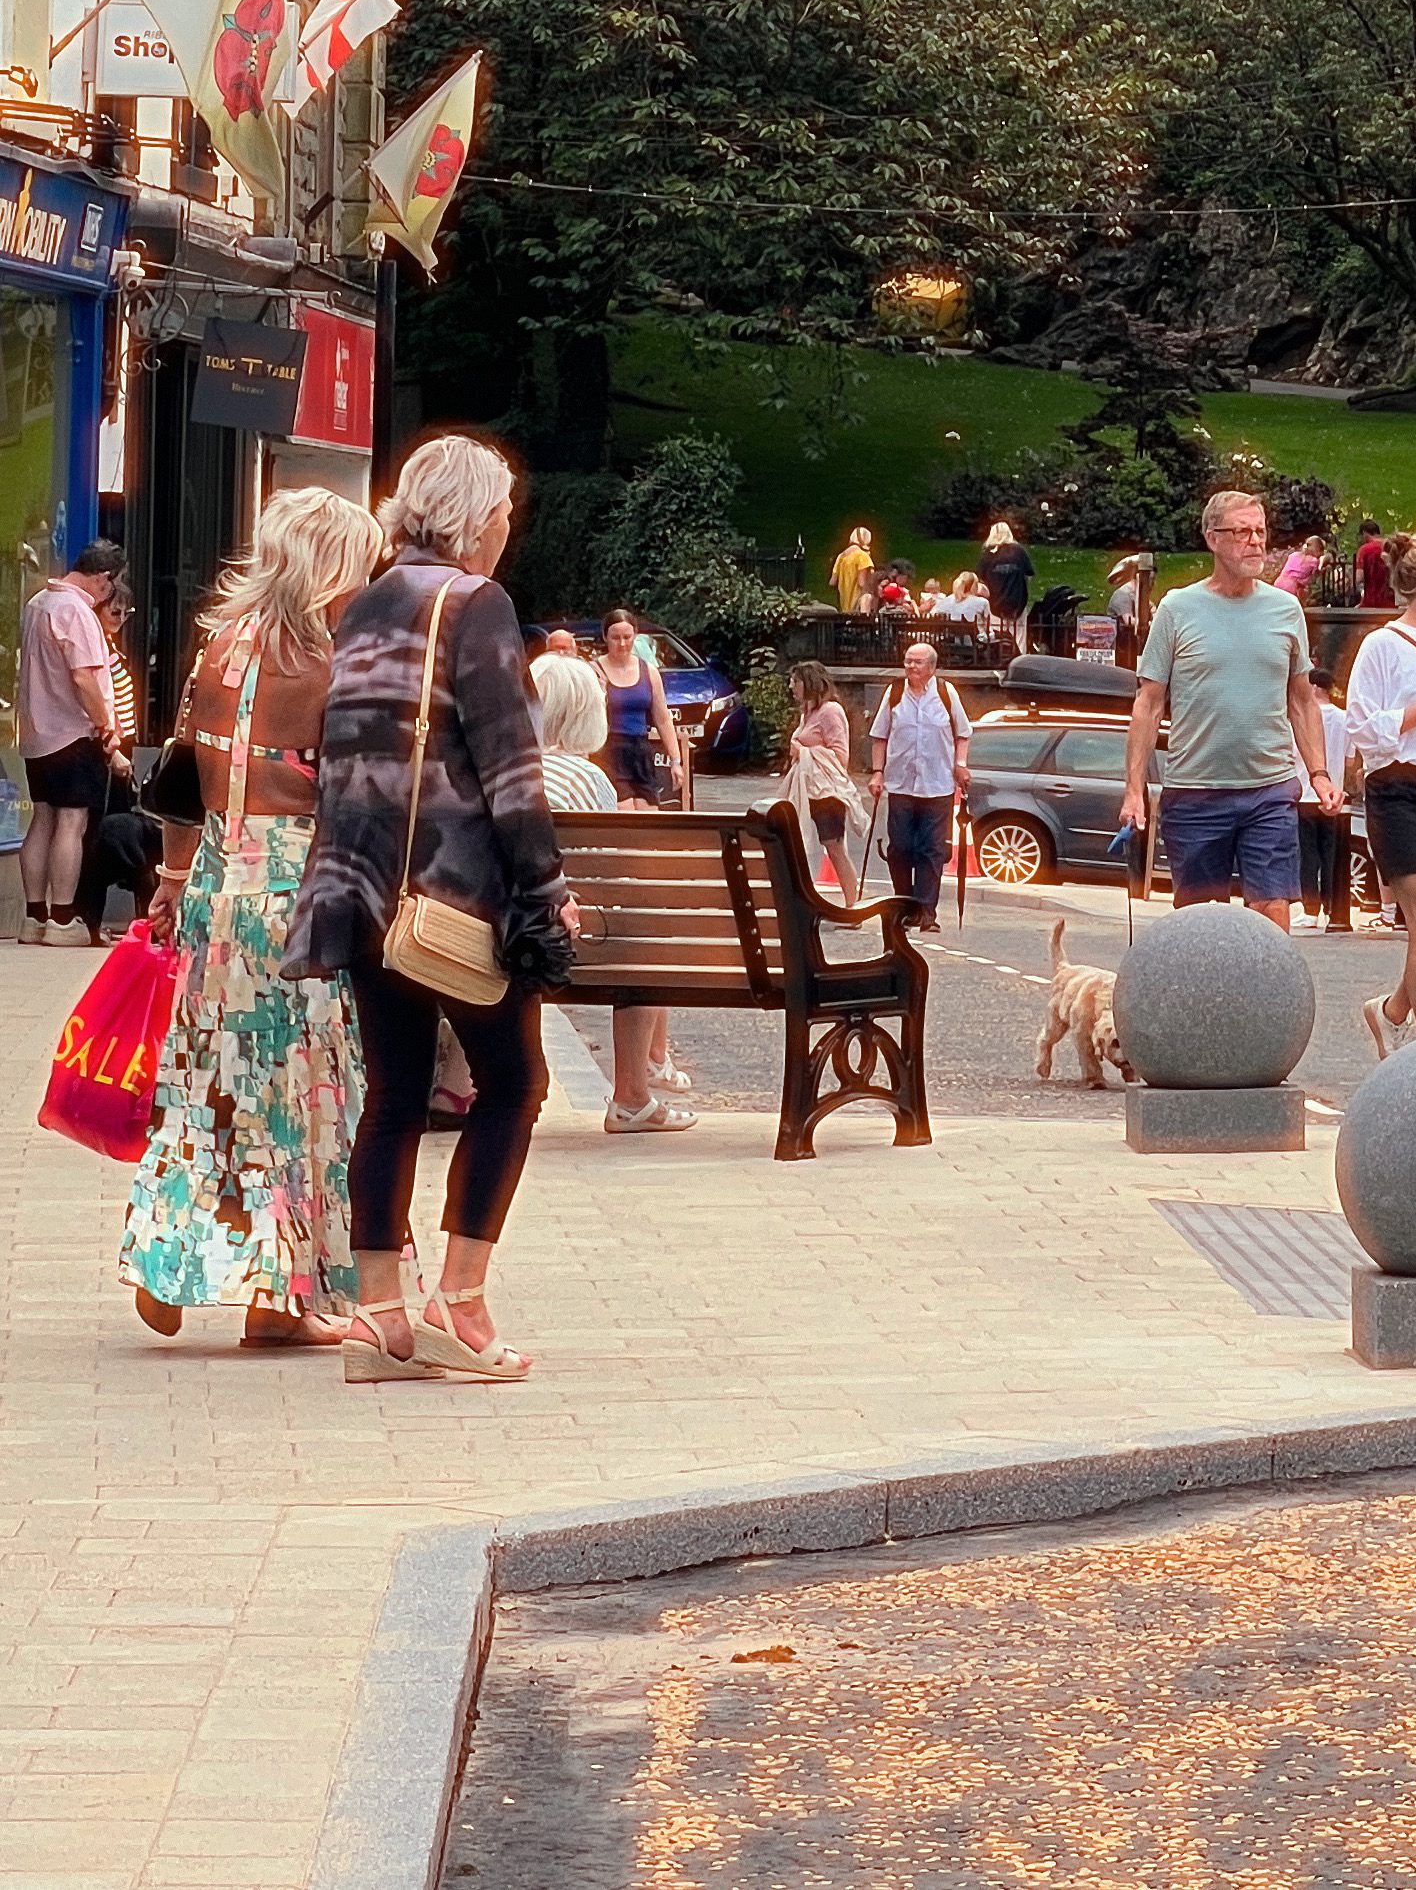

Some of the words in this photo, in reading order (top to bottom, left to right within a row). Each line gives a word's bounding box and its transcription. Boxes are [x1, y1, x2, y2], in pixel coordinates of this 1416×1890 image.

[204, 355, 236, 371] TOMS
[266, 363, 297, 381] TABLE
[53, 1014, 148, 1097] SALE
